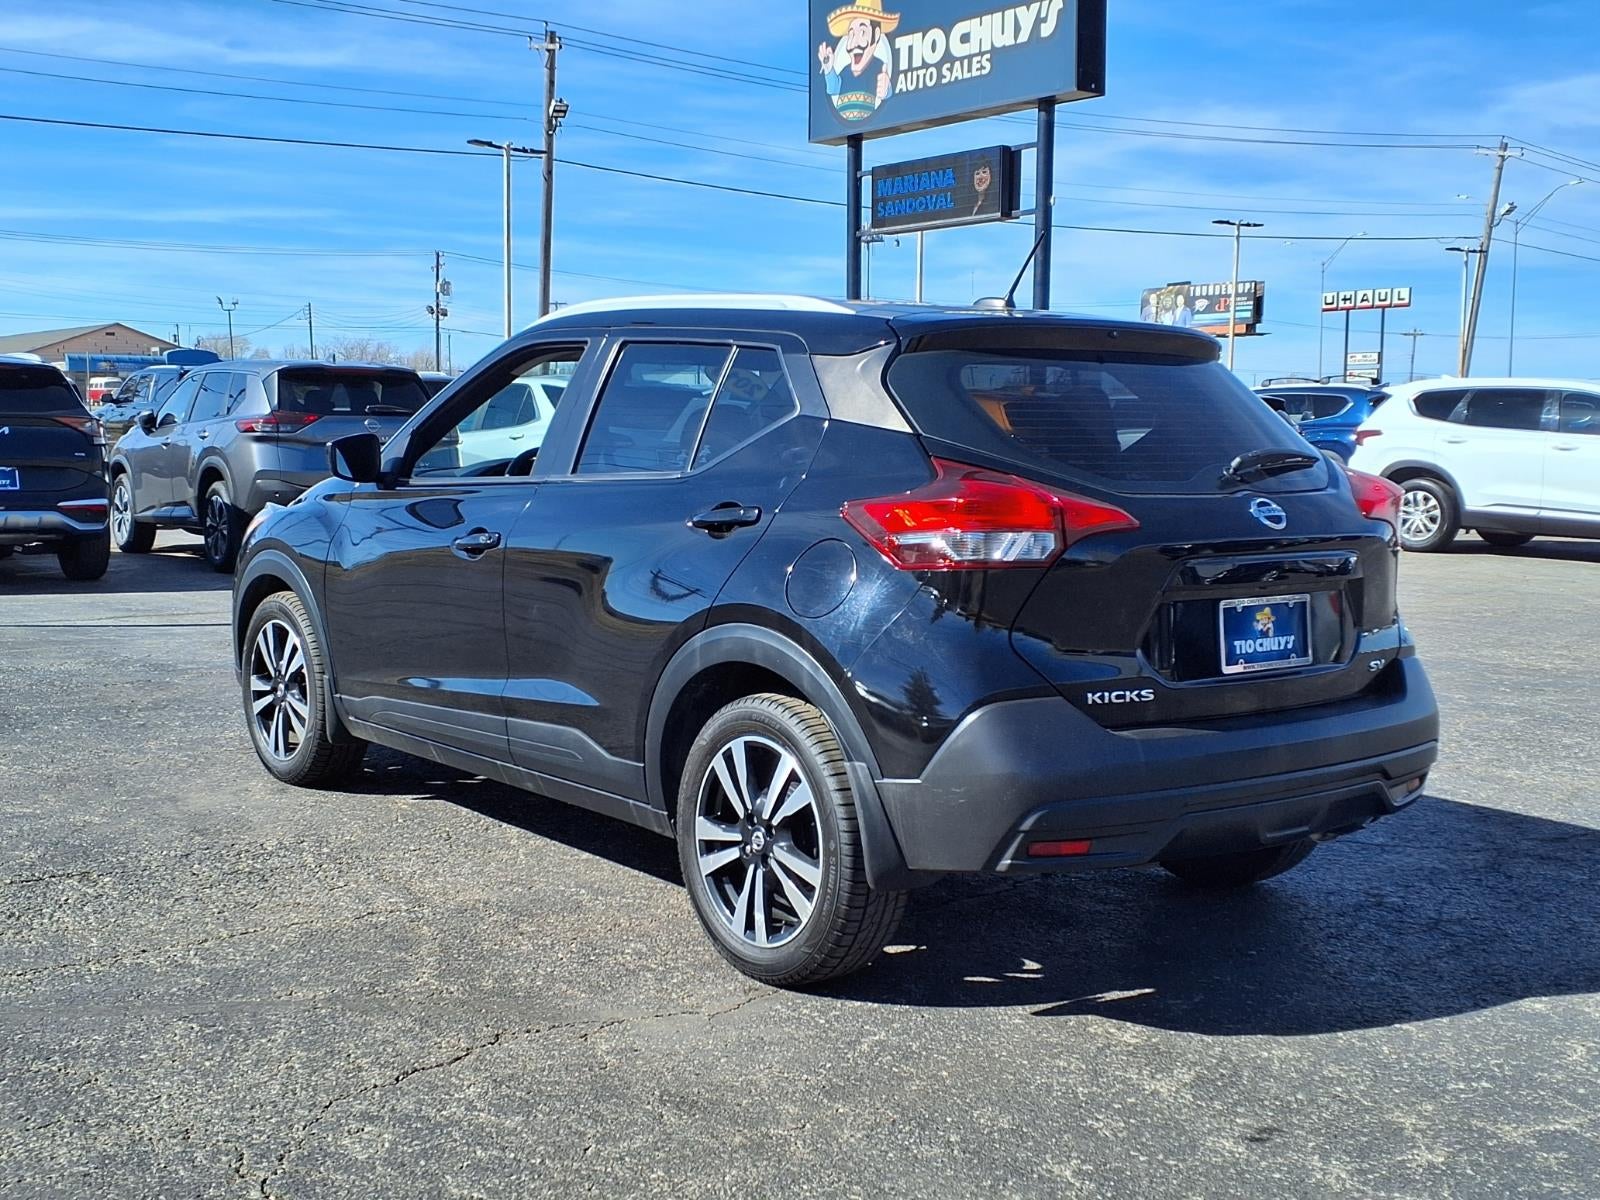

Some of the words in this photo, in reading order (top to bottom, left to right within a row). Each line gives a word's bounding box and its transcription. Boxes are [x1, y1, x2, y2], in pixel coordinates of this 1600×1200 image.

[895, 28, 946, 70] TIO
[949, 0, 1063, 57] CHUY'S
[895, 67, 937, 94] AUTO
[941, 54, 991, 84] SALES
[877, 168, 955, 196] MARIANA
[877, 192, 954, 217] SANDOVAL
[1189, 283, 1233, 297] THUNDER
[1237, 281, 1255, 294] UP!
[1234, 639, 1255, 654] TIO
[1255, 635, 1295, 652] CHUY'S
[1087, 689, 1155, 705] KICKS
